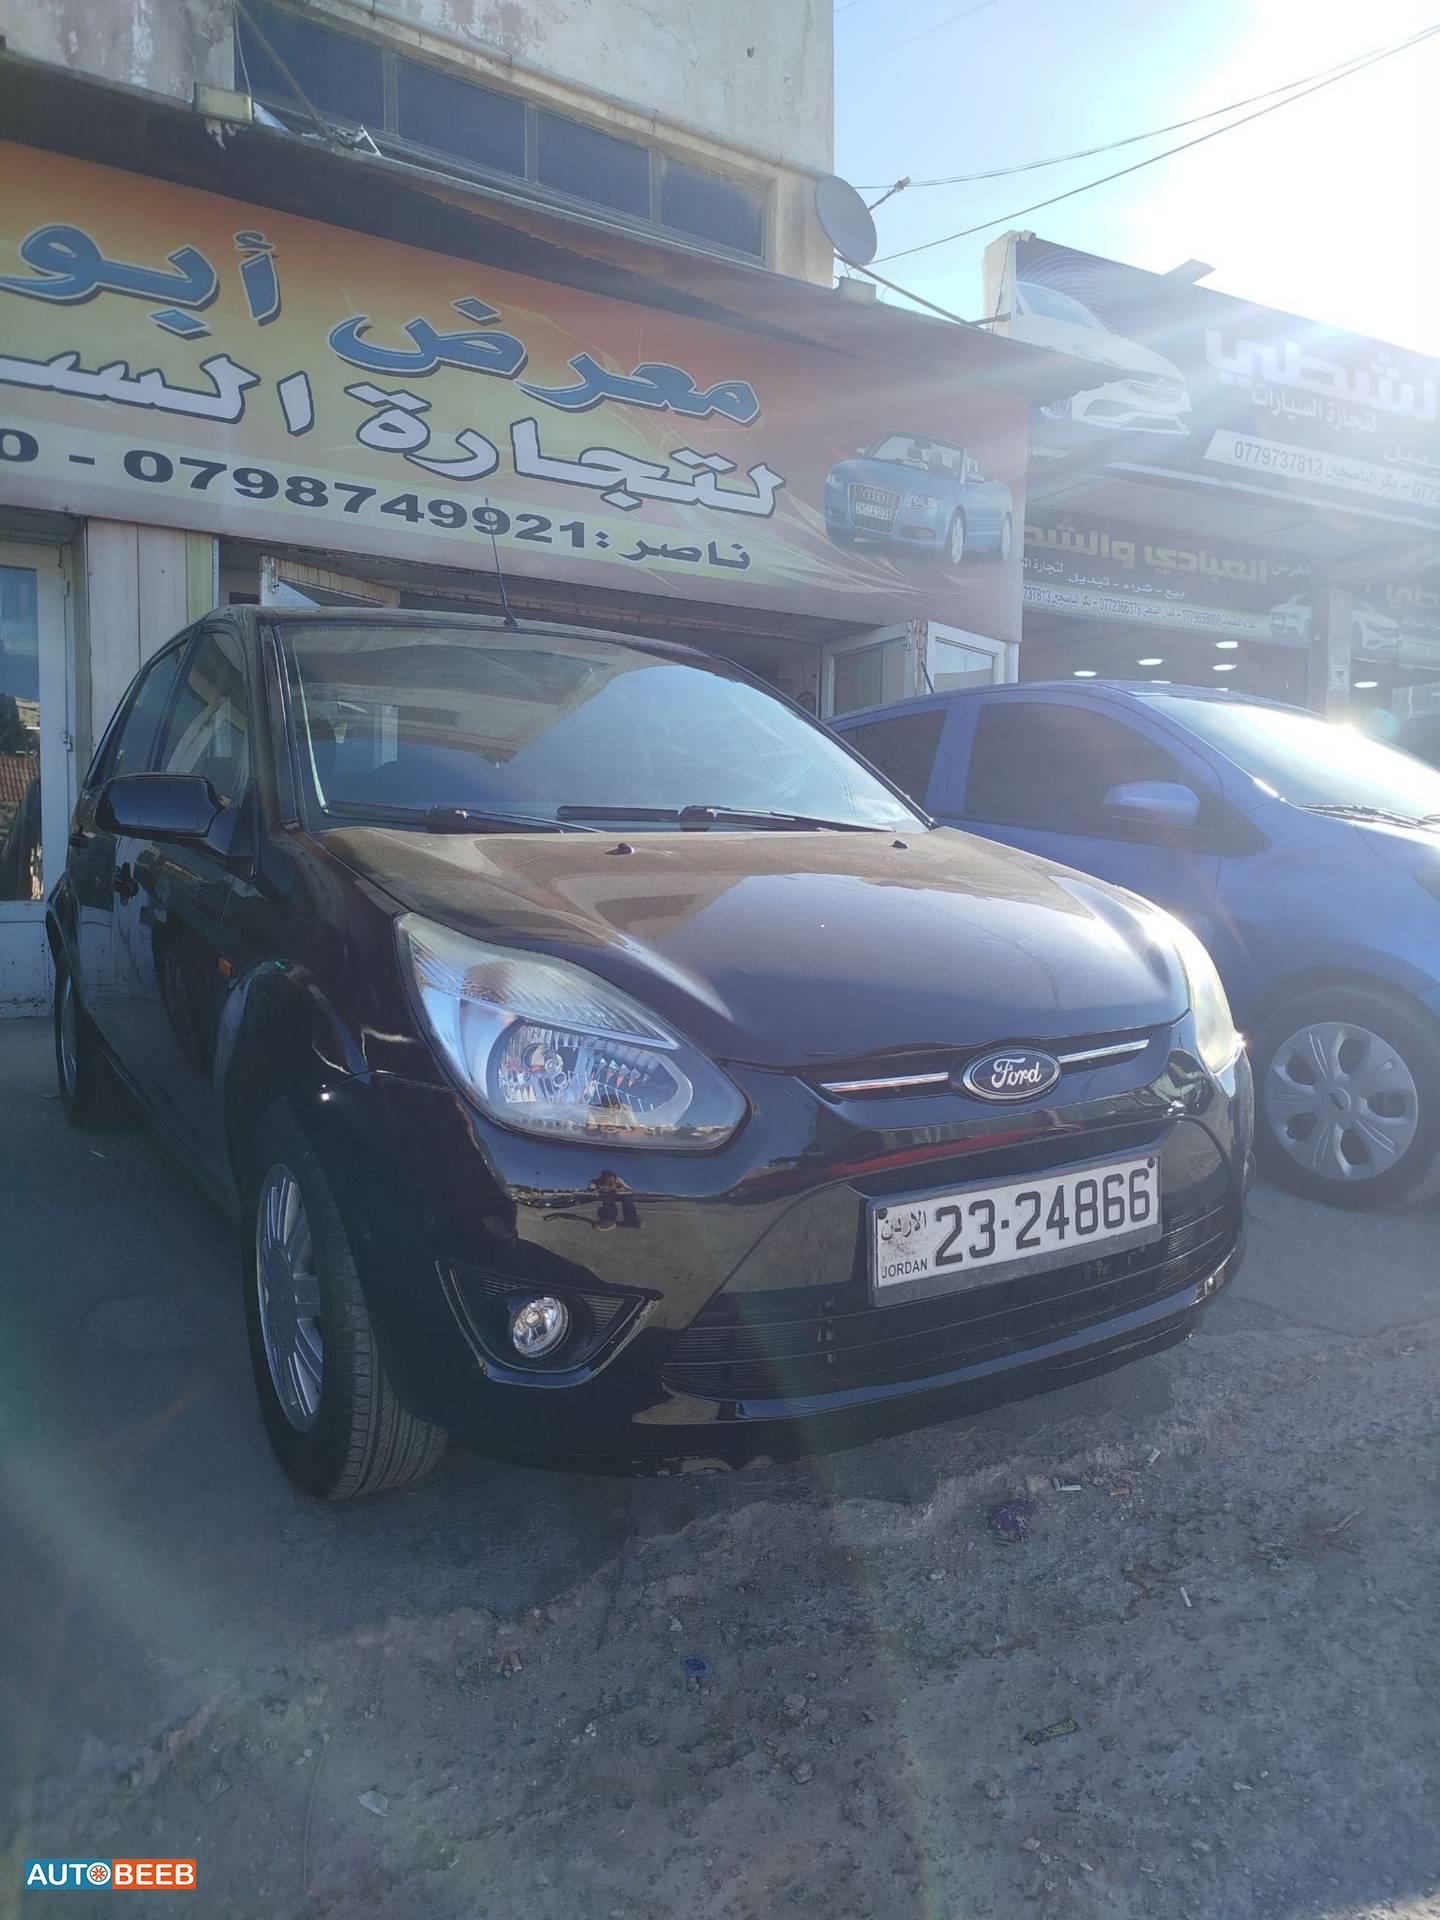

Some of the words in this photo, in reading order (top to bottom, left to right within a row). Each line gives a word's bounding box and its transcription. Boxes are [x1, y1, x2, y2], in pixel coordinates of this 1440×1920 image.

[0, 225, 281, 338] أبو
[328, 297, 761, 424] معرض
[1251, 383, 1323, 423] السيارات
[1325, 399, 1378, 435] لتجارة
[343, 382, 787, 519] لتجارة
[1234, 439, 1324, 478] 0779737813
[123, 449, 587, 549] 0798749921
[991, 1056, 1042, 1088] Ford
[881, 1258, 928, 1279] JORDAN
